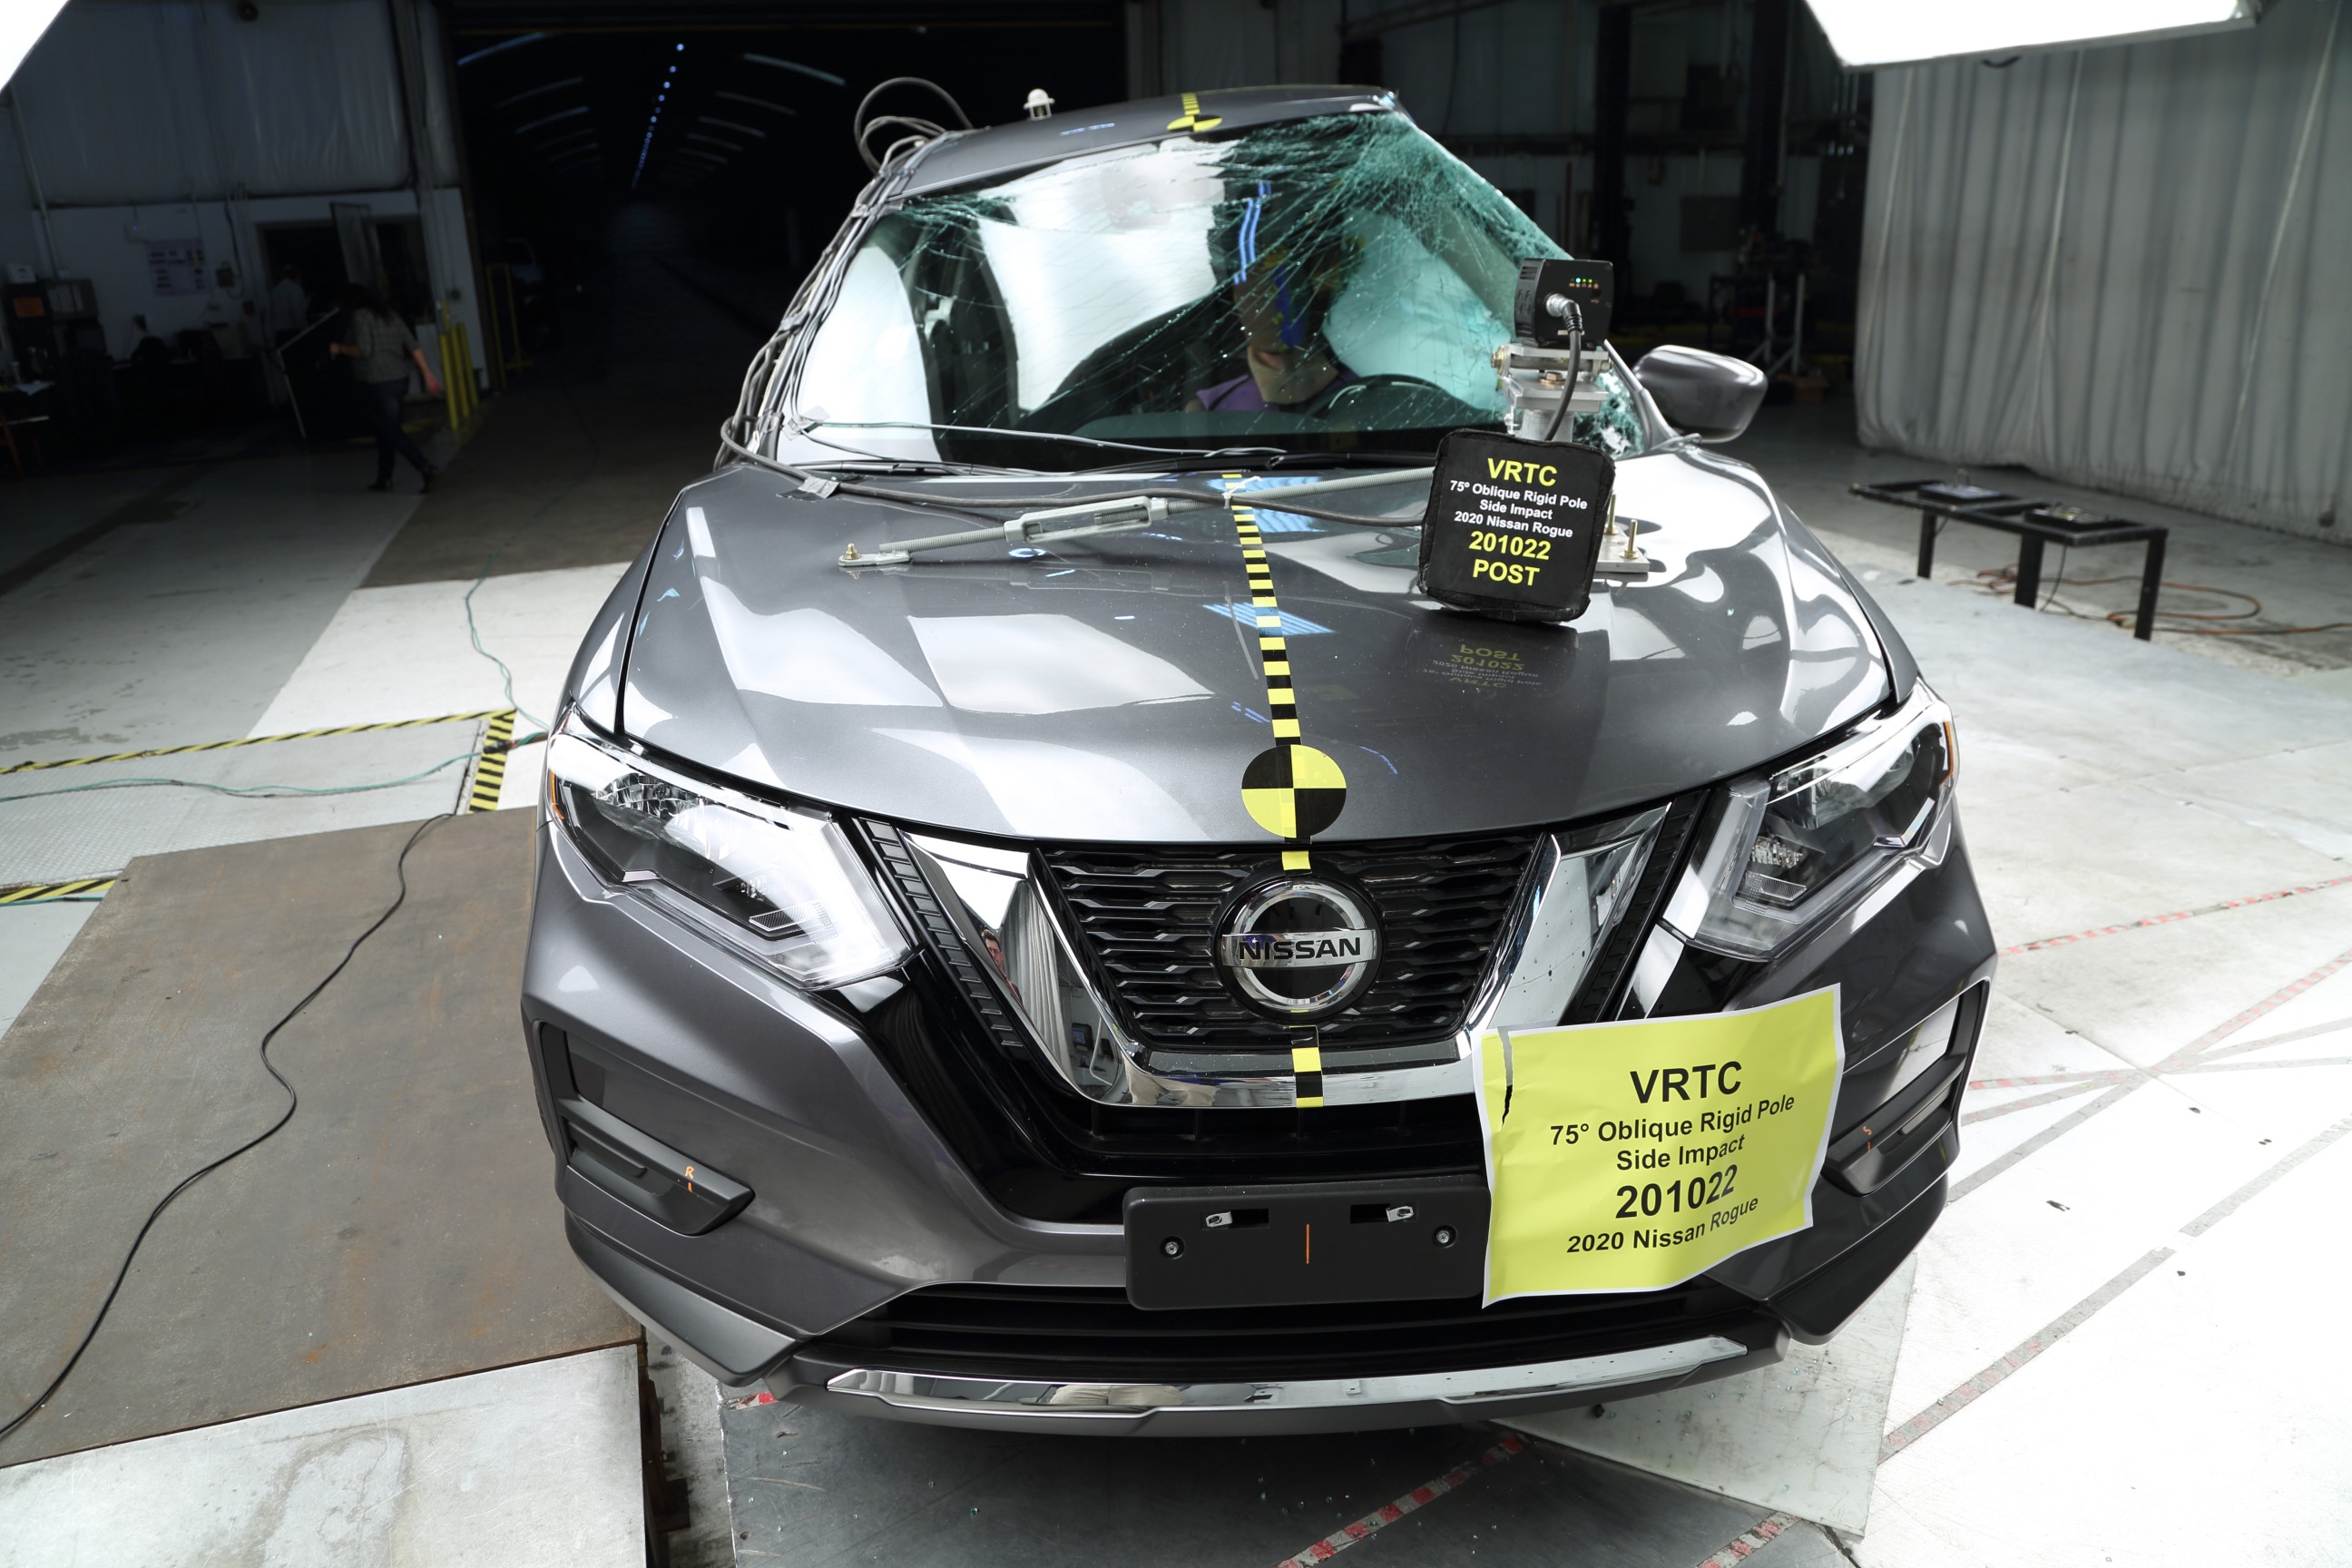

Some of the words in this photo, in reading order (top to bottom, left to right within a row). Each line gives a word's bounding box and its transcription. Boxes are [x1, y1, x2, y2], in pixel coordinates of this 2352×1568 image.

[1487, 457, 1558, 486] VRTC
[1472, 483, 1521, 501] Oblique
[1524, 491, 1557, 505] Rigid
[1559, 495, 1588, 510] Pole
[1479, 499, 1507, 514] Side
[1510, 504, 1553, 519] Impact
[1454, 511, 1484, 524] 2020
[1486, 515, 1529, 532] Nissan
[1532, 522, 1573, 538] Rogue
[1468, 531, 1552, 561] 201022
[1472, 559, 1540, 586] POST
[1239, 936, 1361, 960] NISSAN
[1630, 1061, 1743, 1104] VRTC
[1598, 1119, 1693, 1142] Oblique
[1700, 1104, 1752, 1134] Rigid
[1757, 1094, 1795, 1121] Pole
[1616, 1149, 1671, 1171] Side
[1679, 1133, 1745, 1165] Impact
[684, 1166, 695, 1180] R
[1615, 1164, 1739, 1220] 201022
[1567, 1231, 1624, 1254] 2020
[1633, 1222, 1705, 1249] Nissan
[1710, 1197, 1759, 1231] Rogue
